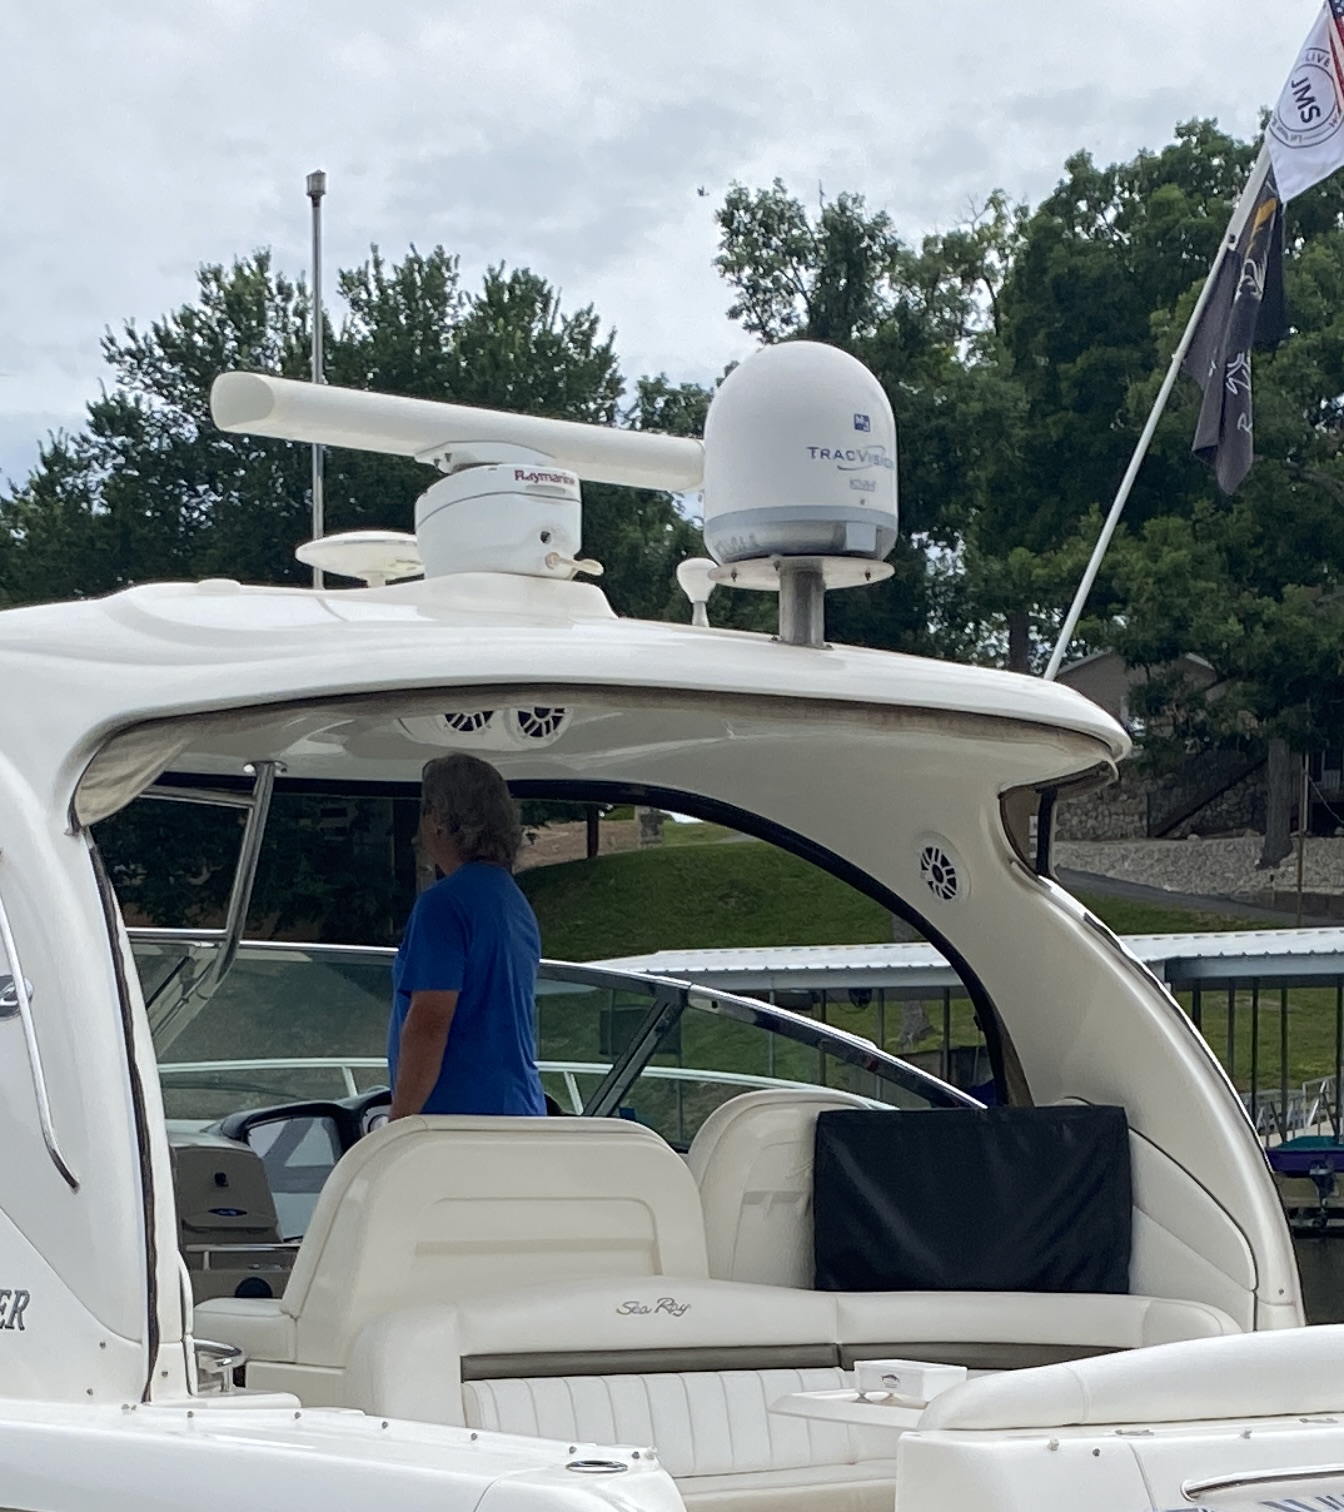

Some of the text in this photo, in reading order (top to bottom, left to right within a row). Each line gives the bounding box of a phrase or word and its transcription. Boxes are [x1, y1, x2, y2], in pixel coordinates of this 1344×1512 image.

[1291, 77, 1321, 124] JMS
[616, 1297, 691, 1318] Sea Ray
